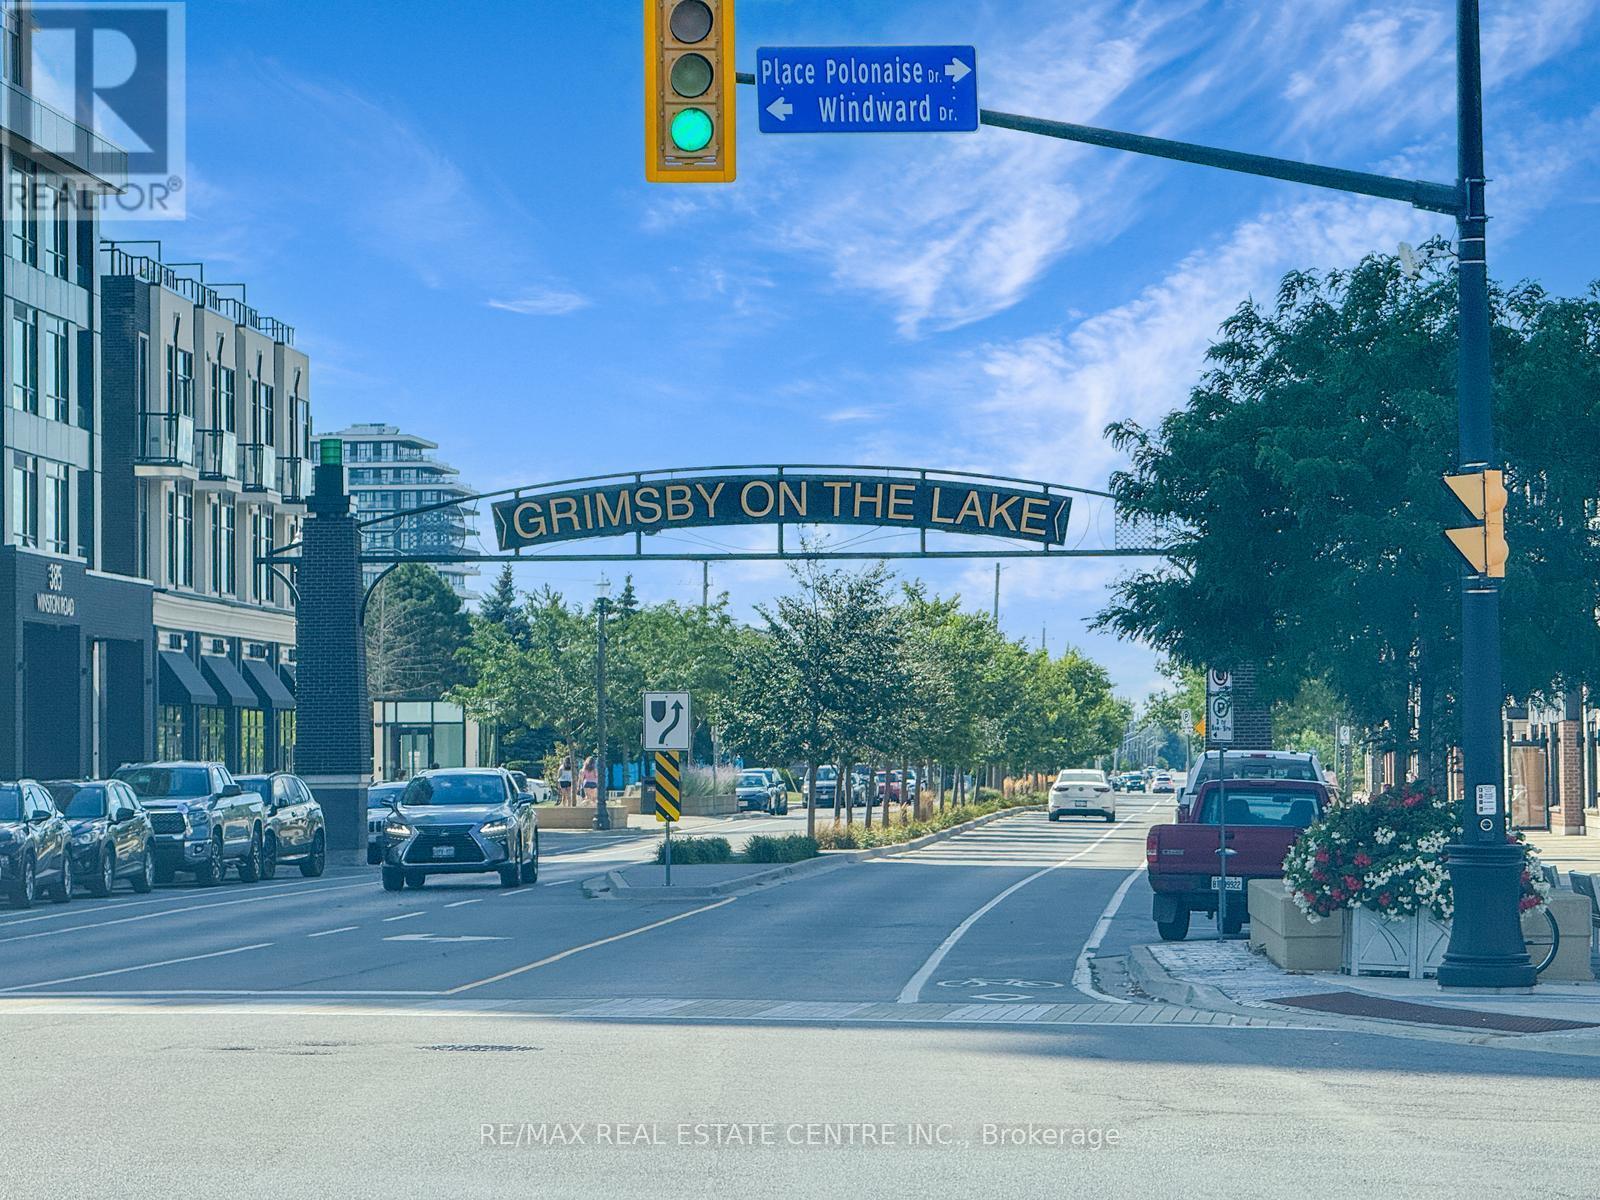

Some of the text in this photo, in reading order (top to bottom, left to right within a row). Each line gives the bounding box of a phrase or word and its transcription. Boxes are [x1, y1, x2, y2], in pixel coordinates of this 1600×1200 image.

[761, 56, 942, 85] Place Polonaise Dr.
[818, 94, 957, 123] Windward Dr.
[513, 480, 1050, 539] GRIMSBY ON THE LAKE
